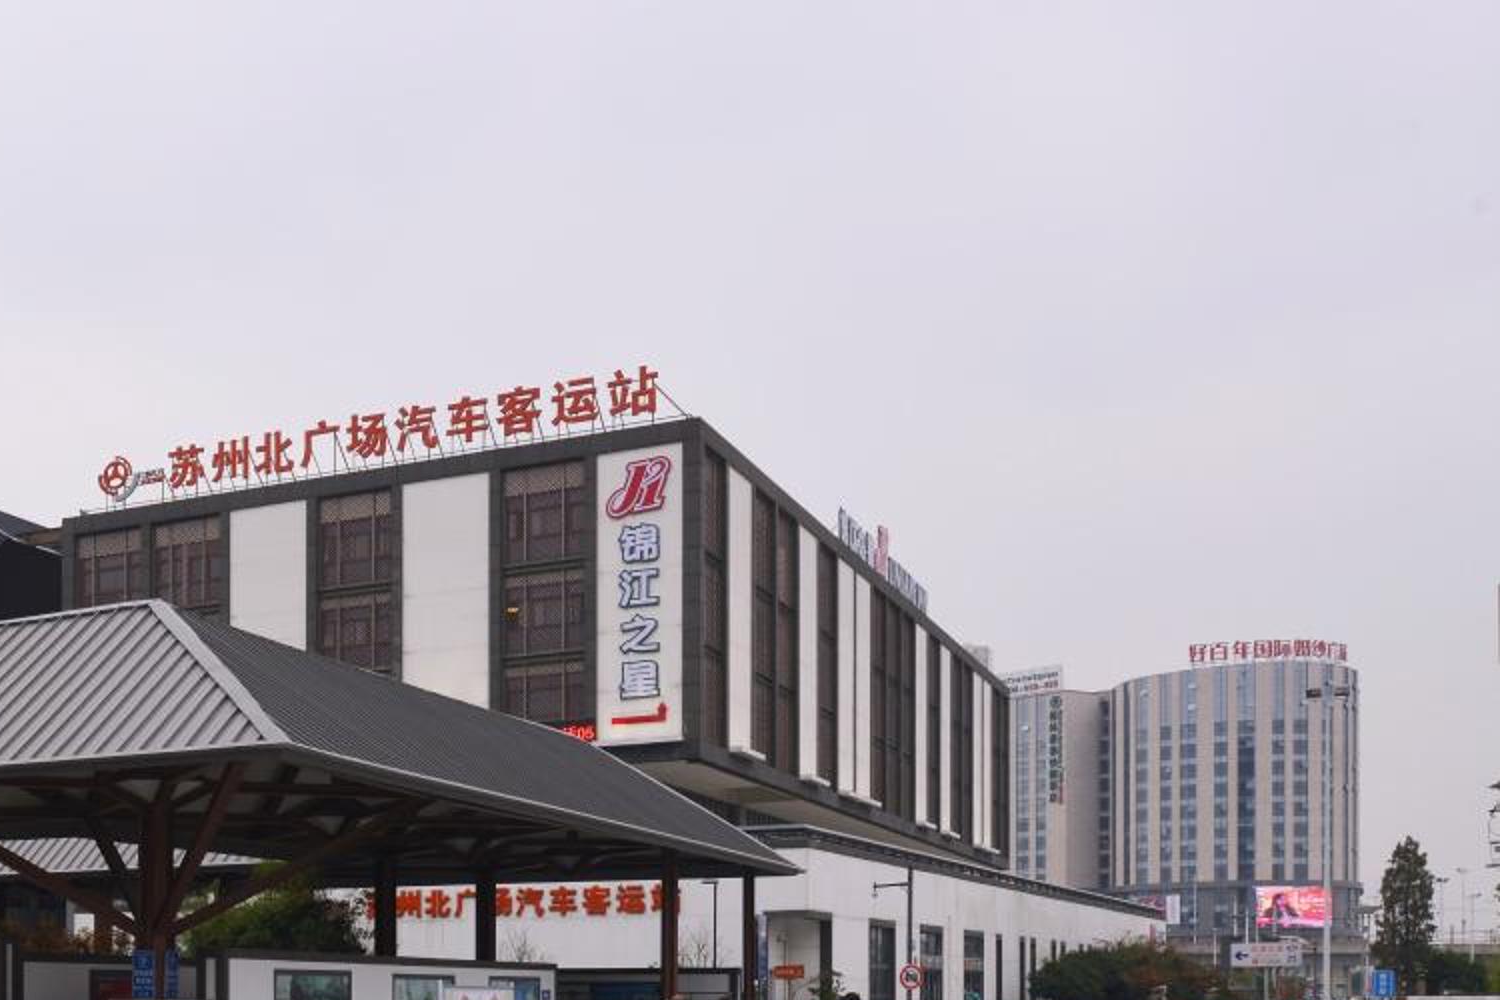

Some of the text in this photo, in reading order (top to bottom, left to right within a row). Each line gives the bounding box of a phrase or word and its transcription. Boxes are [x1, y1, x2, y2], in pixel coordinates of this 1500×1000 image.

[167, 365, 659, 489] 苏州北广场汽车客运站
[619, 522, 660, 700] 锦江之星
[366, 884, 681, 919] 州北广场汽车客运
